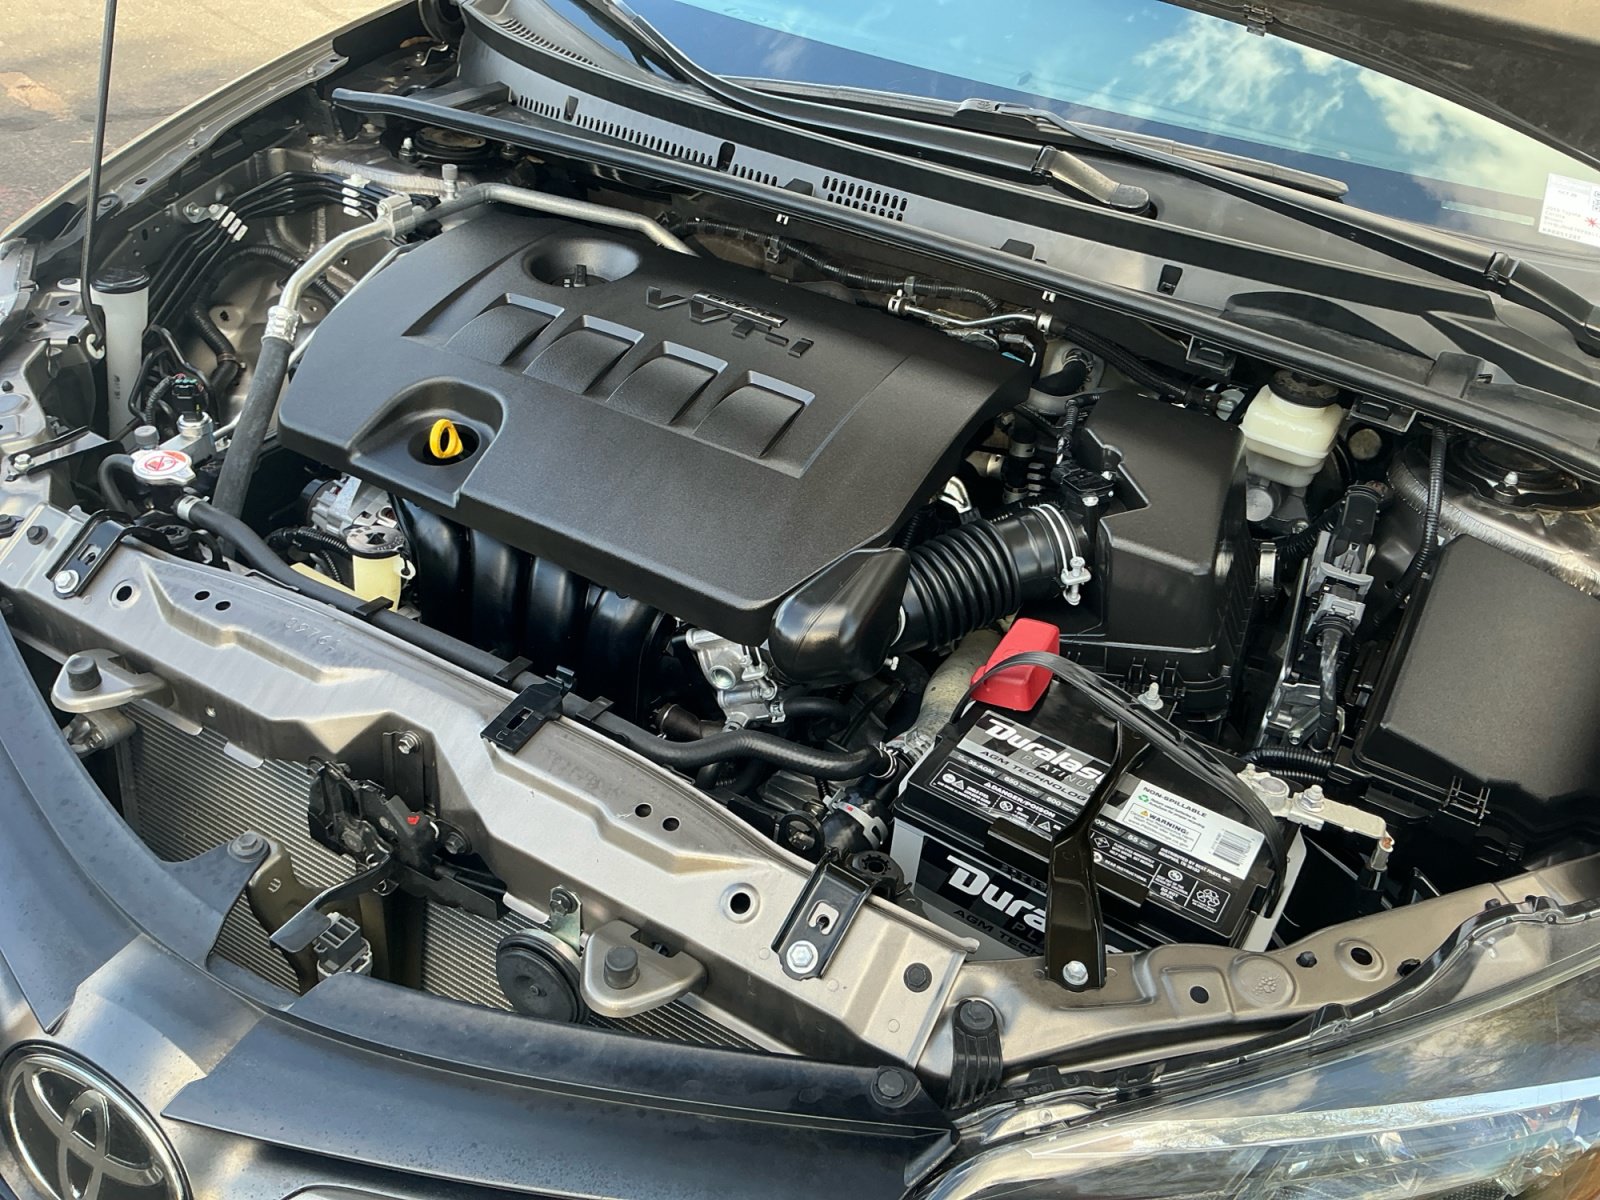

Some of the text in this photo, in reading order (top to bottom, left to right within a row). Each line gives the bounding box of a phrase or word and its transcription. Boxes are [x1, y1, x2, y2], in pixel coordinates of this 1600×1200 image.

[980, 750, 1010, 768] AGM
[1012, 764, 1089, 802] TECHNOLOG
[991, 784, 1056, 818] DANGER/POISON
[1143, 786, 1206, 818] NON-SPILLABLE
[1149, 813, 1189, 834] WARNING:
[947, 855, 1046, 933] Dura
